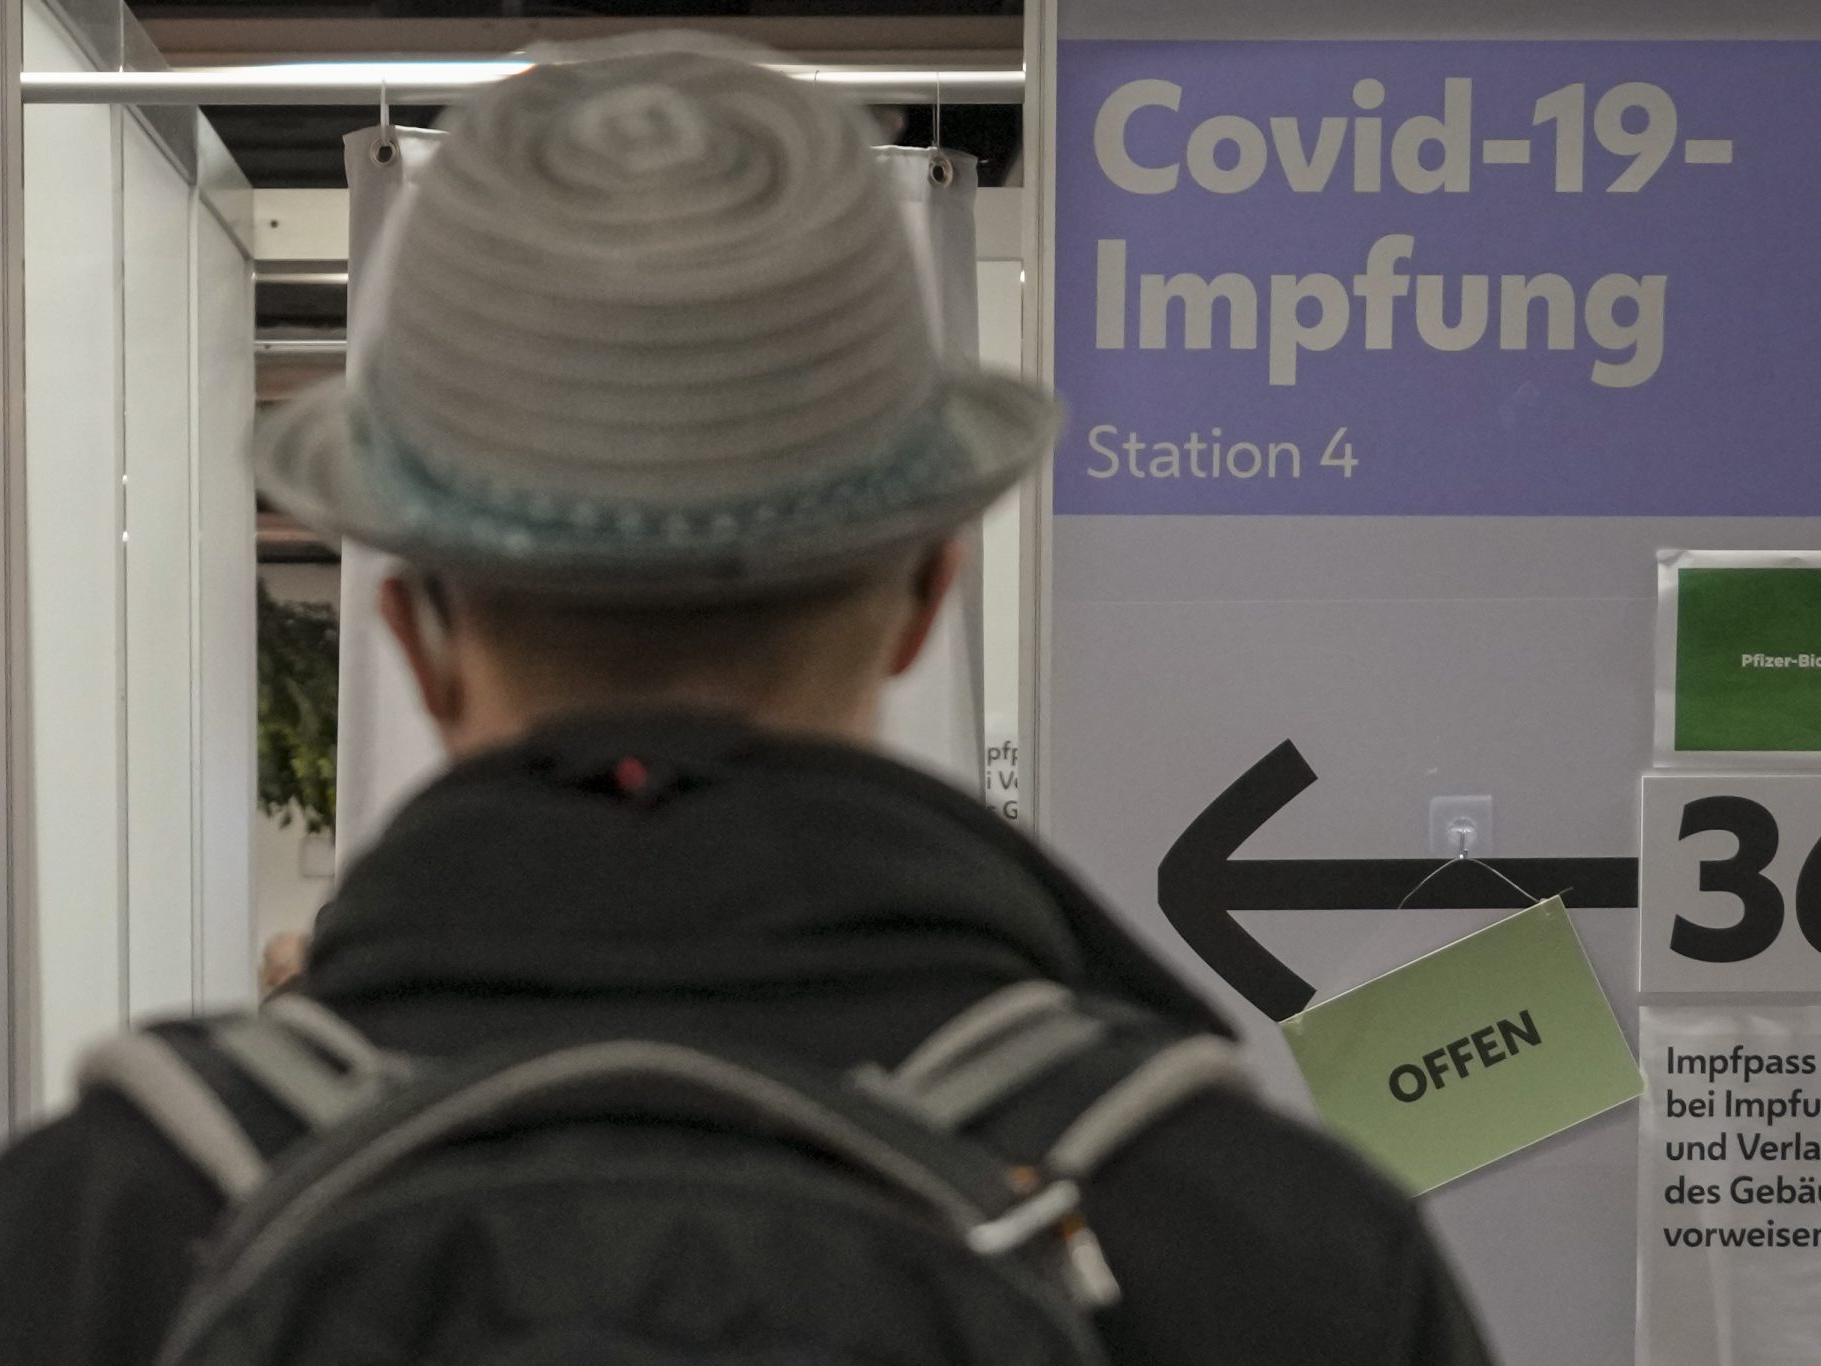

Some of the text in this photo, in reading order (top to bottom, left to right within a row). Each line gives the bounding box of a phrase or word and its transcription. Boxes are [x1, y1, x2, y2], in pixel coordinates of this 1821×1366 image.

[1093, 77, 1733, 195] Covid-19-
[1095, 233, 1668, 388] Impfung
[1086, 424, 1359, 479] Station 4
[1669, 795, 1821, 964] 3
[1388, 1009, 1542, 1103] OFFEN
[1667, 1044, 1817, 1084] Impfpass
[1667, 1088, 1821, 1127] bei Impfu
[1666, 1131, 1821, 1161] und Verla
[1664, 1175, 1821, 1205] des Gebä
